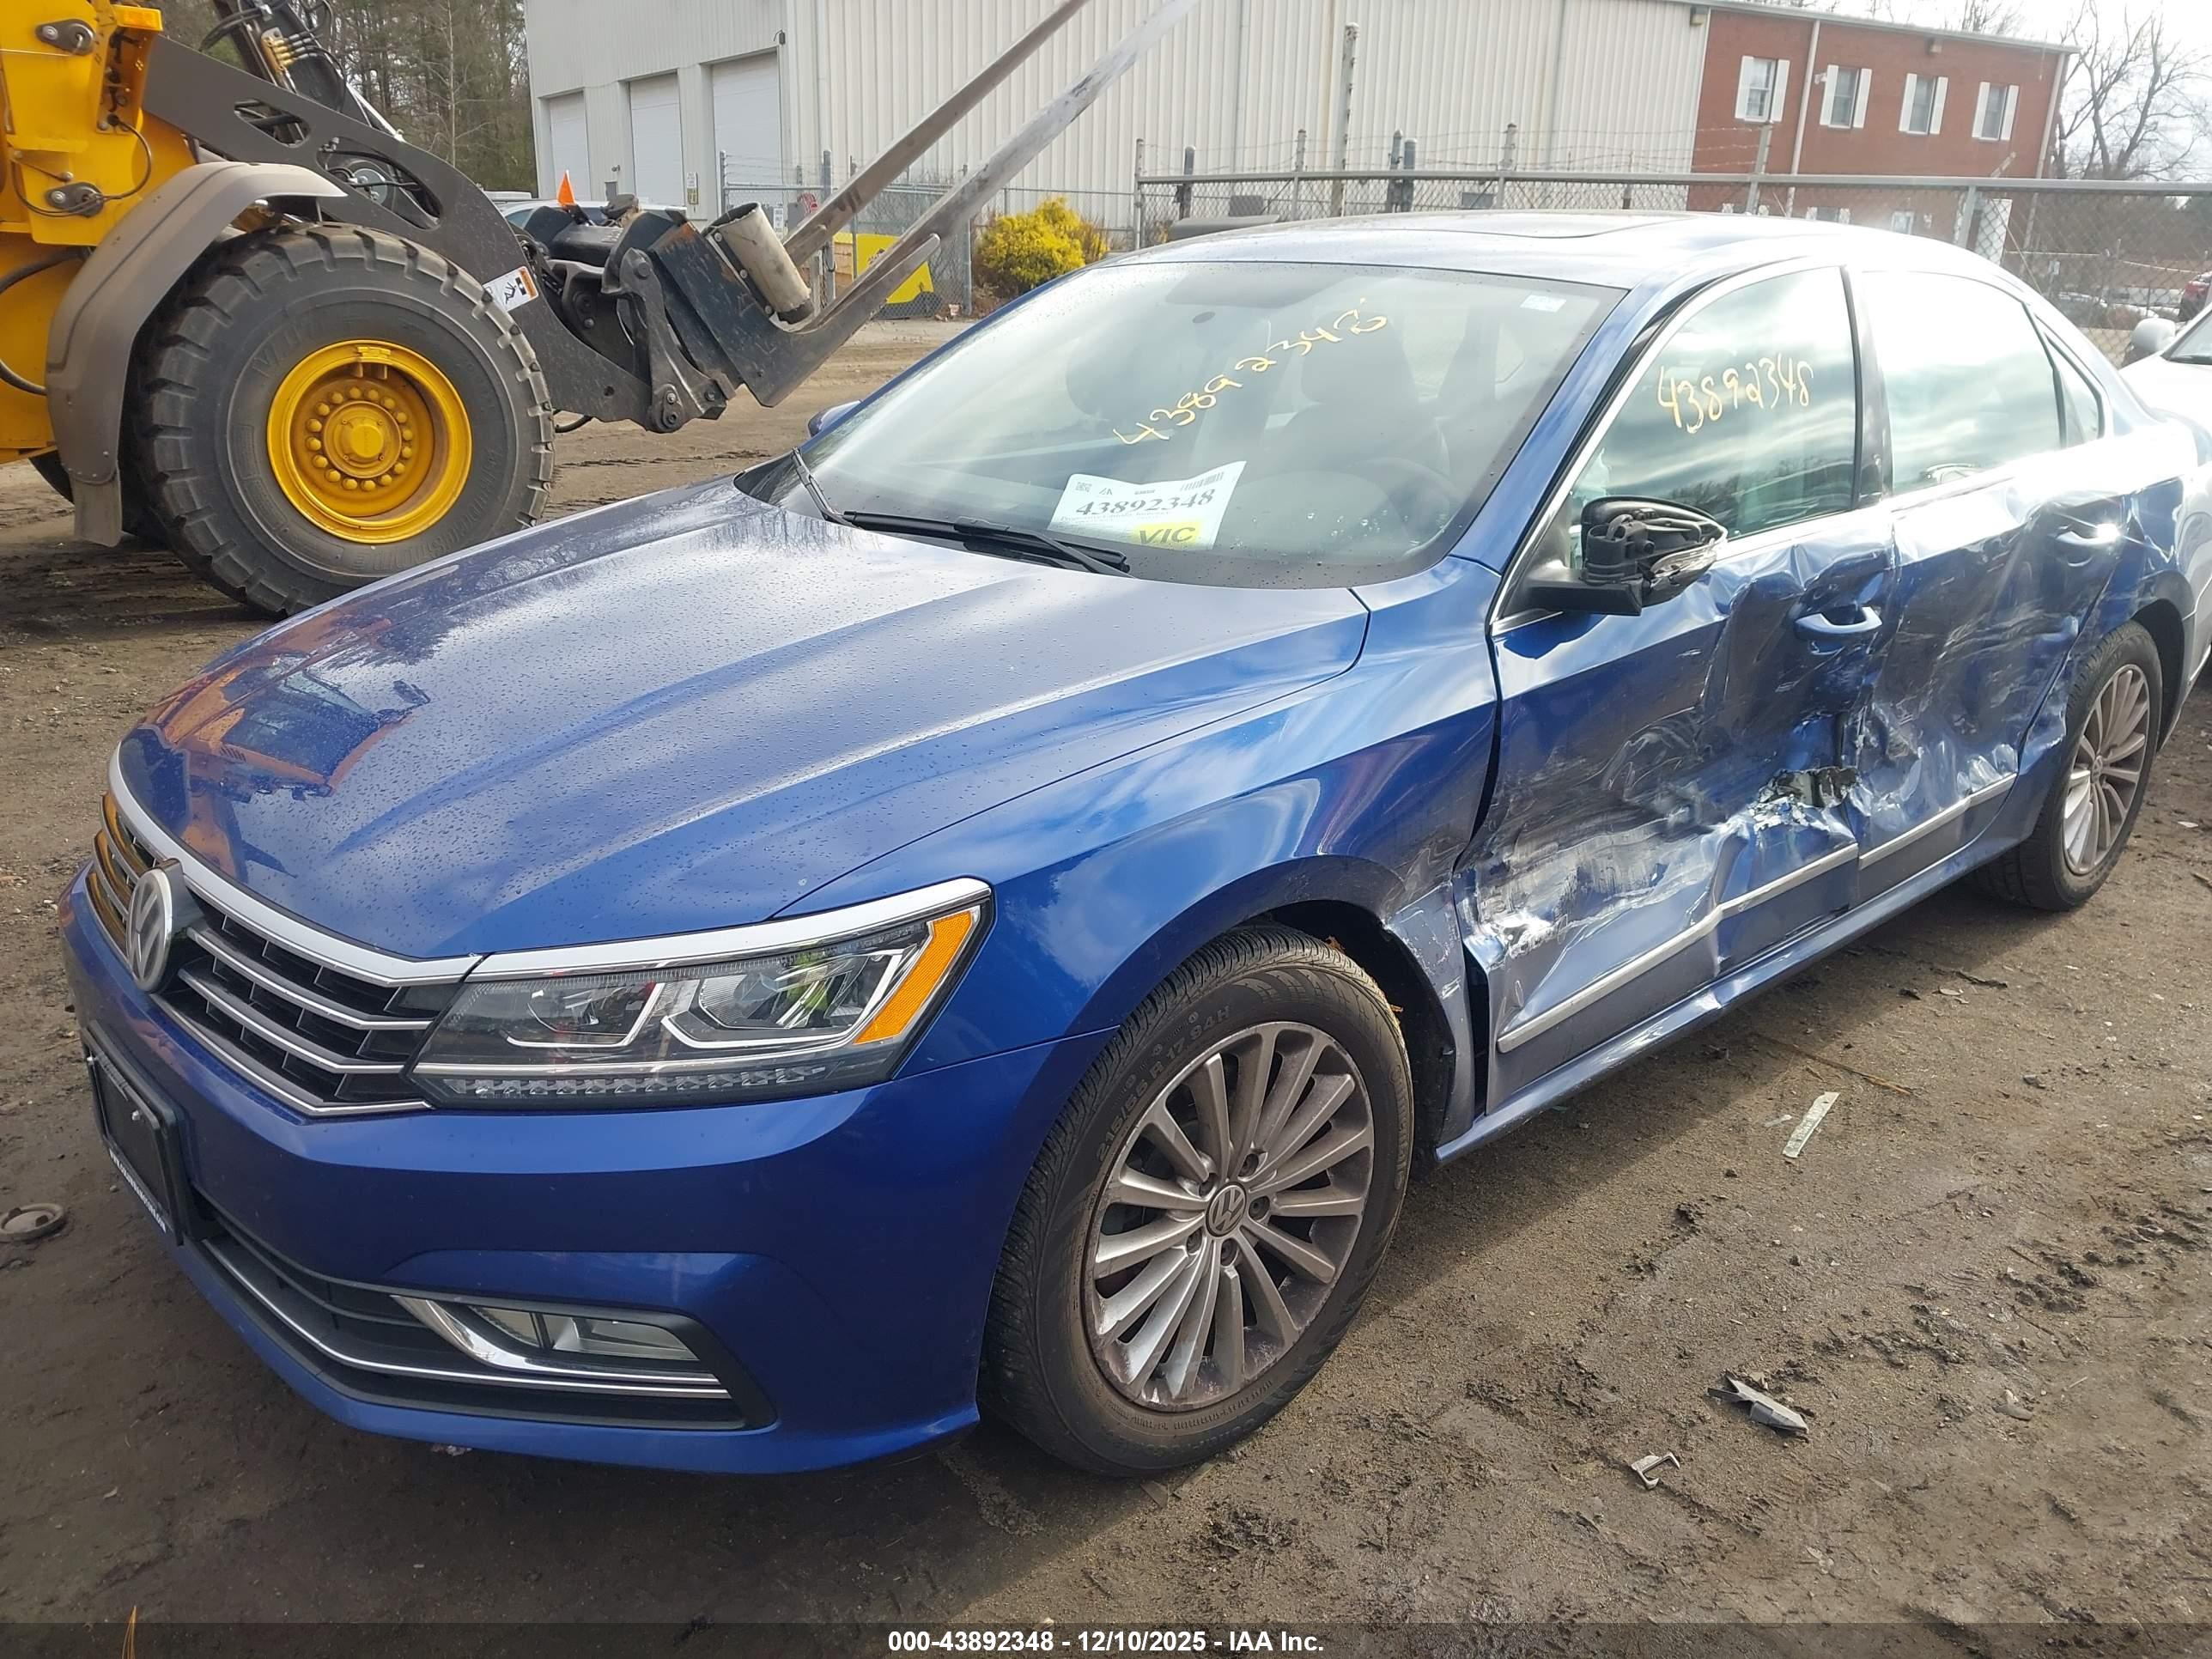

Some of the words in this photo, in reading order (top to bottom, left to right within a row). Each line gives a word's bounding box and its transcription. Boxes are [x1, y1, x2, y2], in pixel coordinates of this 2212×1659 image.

[1657, 353, 1814, 434] 43892348
[1075, 488, 1216, 517] 43892348
[1138, 526, 1196, 546] VIC
[1208, 1185, 1246, 1235] VW
